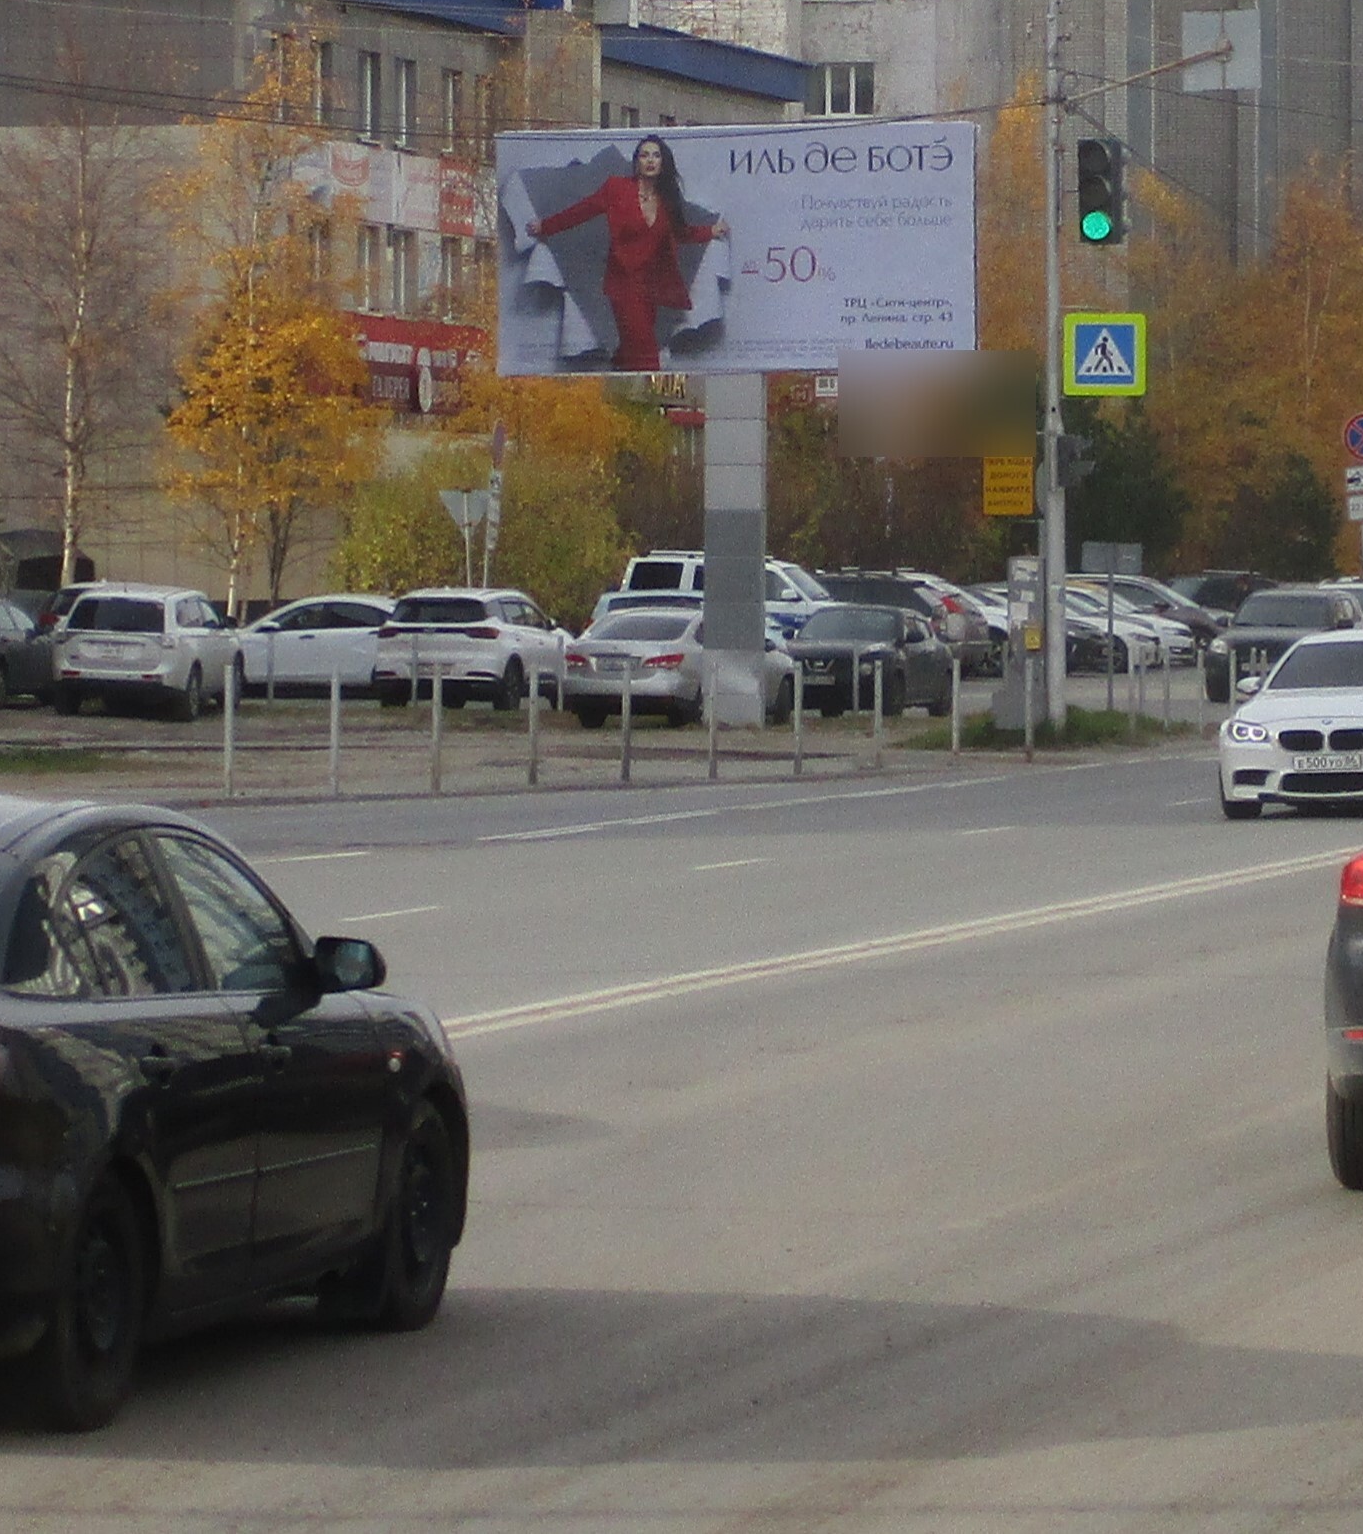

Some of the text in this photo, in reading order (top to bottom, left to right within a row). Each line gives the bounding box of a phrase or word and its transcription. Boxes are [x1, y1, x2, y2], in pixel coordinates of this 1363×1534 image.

[729, 148, 796, 174] ИЛЬ
[891, 196, 954, 211] радость
[856, 213, 893, 228] себе
[897, 211, 954, 227] больше
[843, 297, 868, 310] ТРЦ
[938, 311, 954, 323] 43
